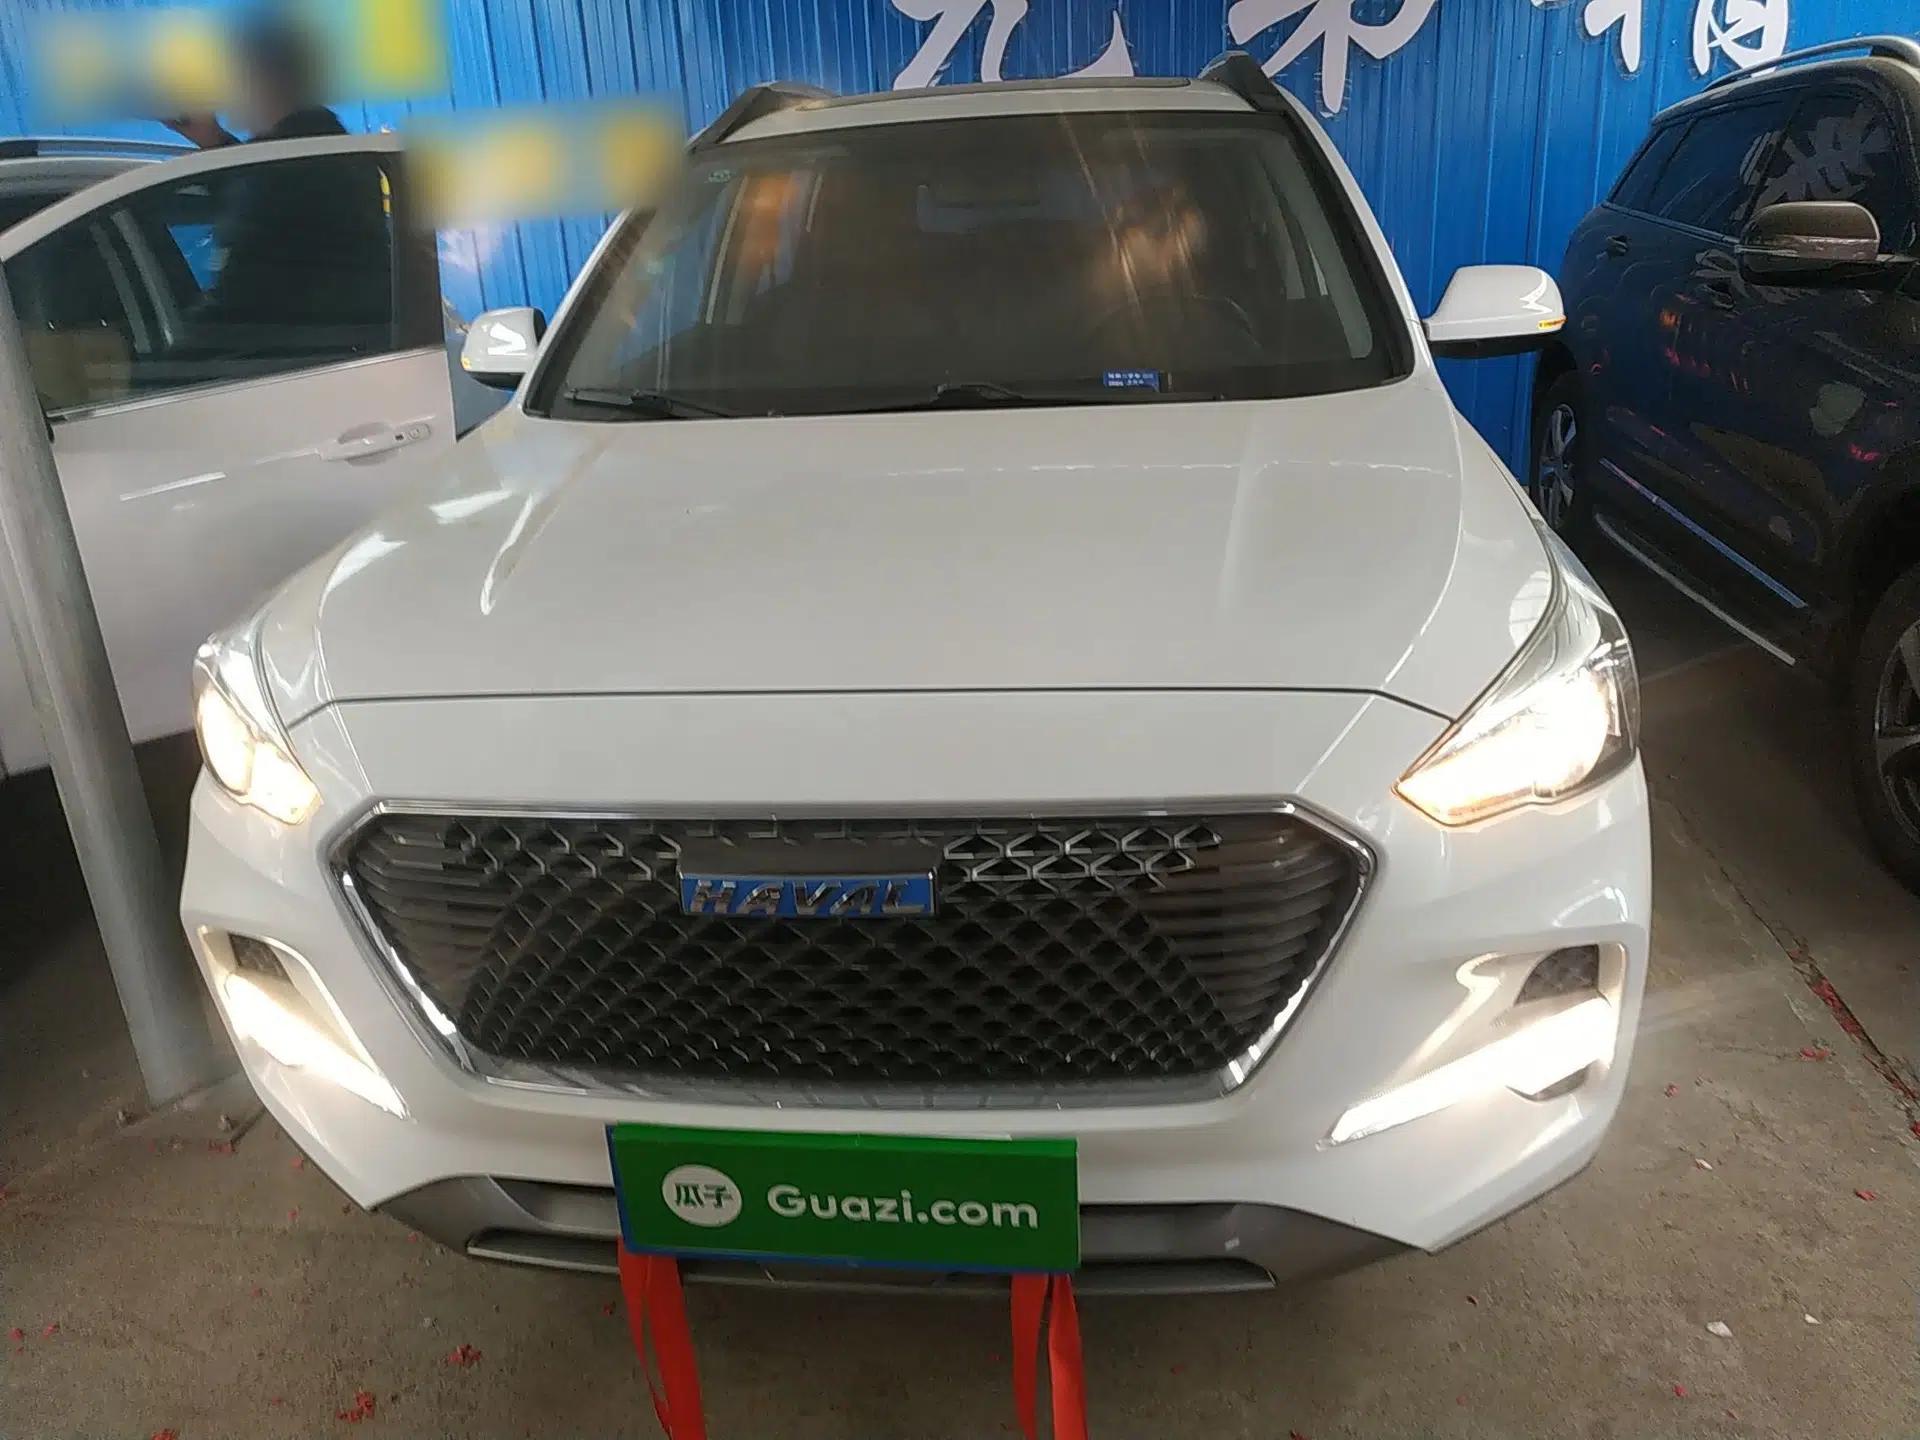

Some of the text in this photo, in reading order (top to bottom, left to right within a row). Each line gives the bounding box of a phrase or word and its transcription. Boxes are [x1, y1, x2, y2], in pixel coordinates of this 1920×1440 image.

[690, 879, 925, 915] HAVAL
[674, 1183, 733, 1208] 瓜子
[767, 1184, 1039, 1229] Guazi.com
